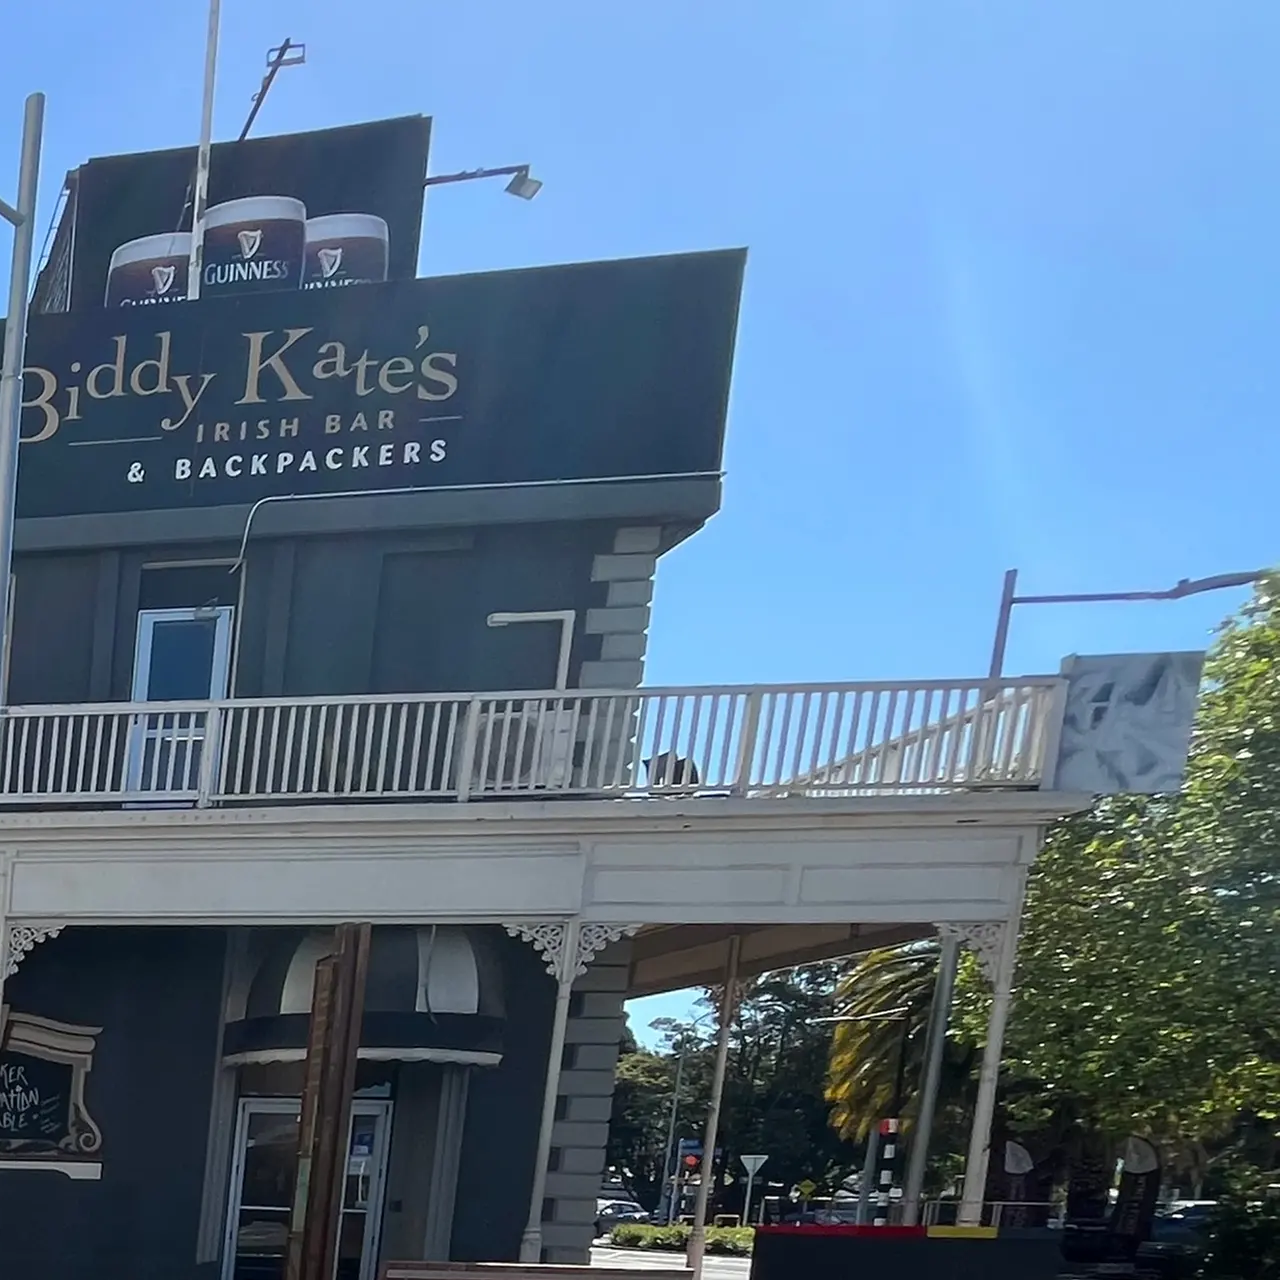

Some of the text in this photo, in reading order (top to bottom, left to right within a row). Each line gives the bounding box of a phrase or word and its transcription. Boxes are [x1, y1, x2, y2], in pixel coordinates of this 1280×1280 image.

[204, 260, 289, 286] GUINNESS
[233, 325, 459, 404] Kate's
[197, 409, 397, 443] IRISH BAR
[126, 439, 448, 483] & BACKPACKERS
